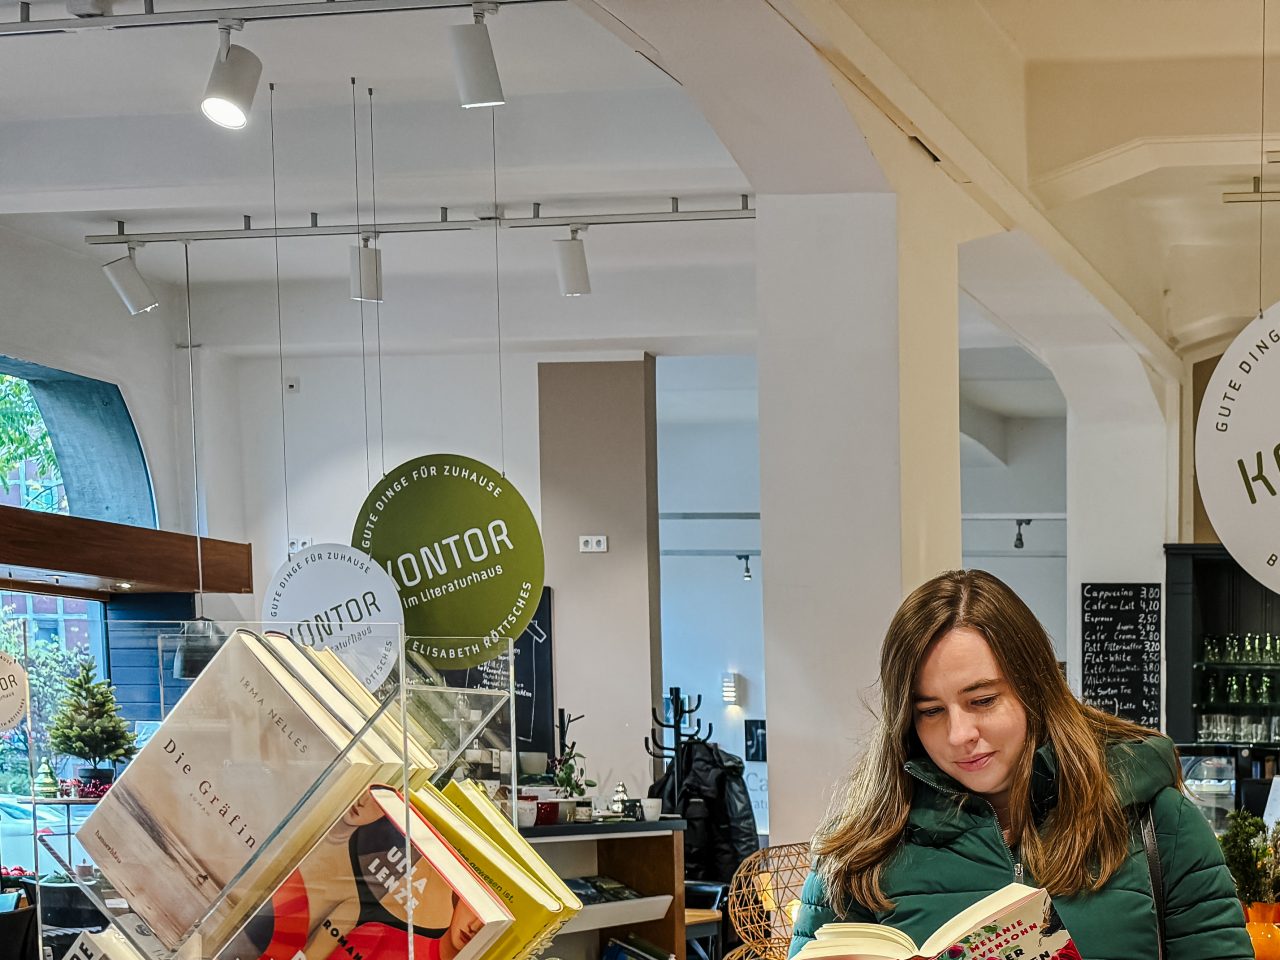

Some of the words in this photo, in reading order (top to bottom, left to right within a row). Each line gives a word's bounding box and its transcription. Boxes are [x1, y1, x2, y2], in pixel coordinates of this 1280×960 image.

[1216, 380, 1241, 432] GUTE
[362, 512, 378, 548] GUTE
[376, 477, 408, 511] DINGE
[412, 466, 437, 481] FÜR
[444, 466, 502, 498] ZUHAUSE
[270, 591, 282, 617] GUTE
[280, 562, 302, 588] DINGE
[305, 553, 322, 564] FÜR
[328, 552, 370, 574] ZUHAUSE
[403, 596, 418, 608] im
[421, 564, 502, 603] Literaturhaus
[1084, 585, 1133, 599] Cappuccino
[290, 591, 380, 647] ONTOR
[412, 640, 480, 658] ELISABETH
[484, 581, 532, 648] RÖTTSCHES
[366, 640, 392, 686] ÖTTSCHES
[240, 677, 265, 706] IRMA
[268, 708, 308, 754] NELLES
[163, 738, 192, 775] Die
[198, 780, 256, 848] Gräfin
[368, 858, 419, 913] LENZE
[387, 846, 427, 894] ULLA
[969, 919, 1024, 953] MELANIE
